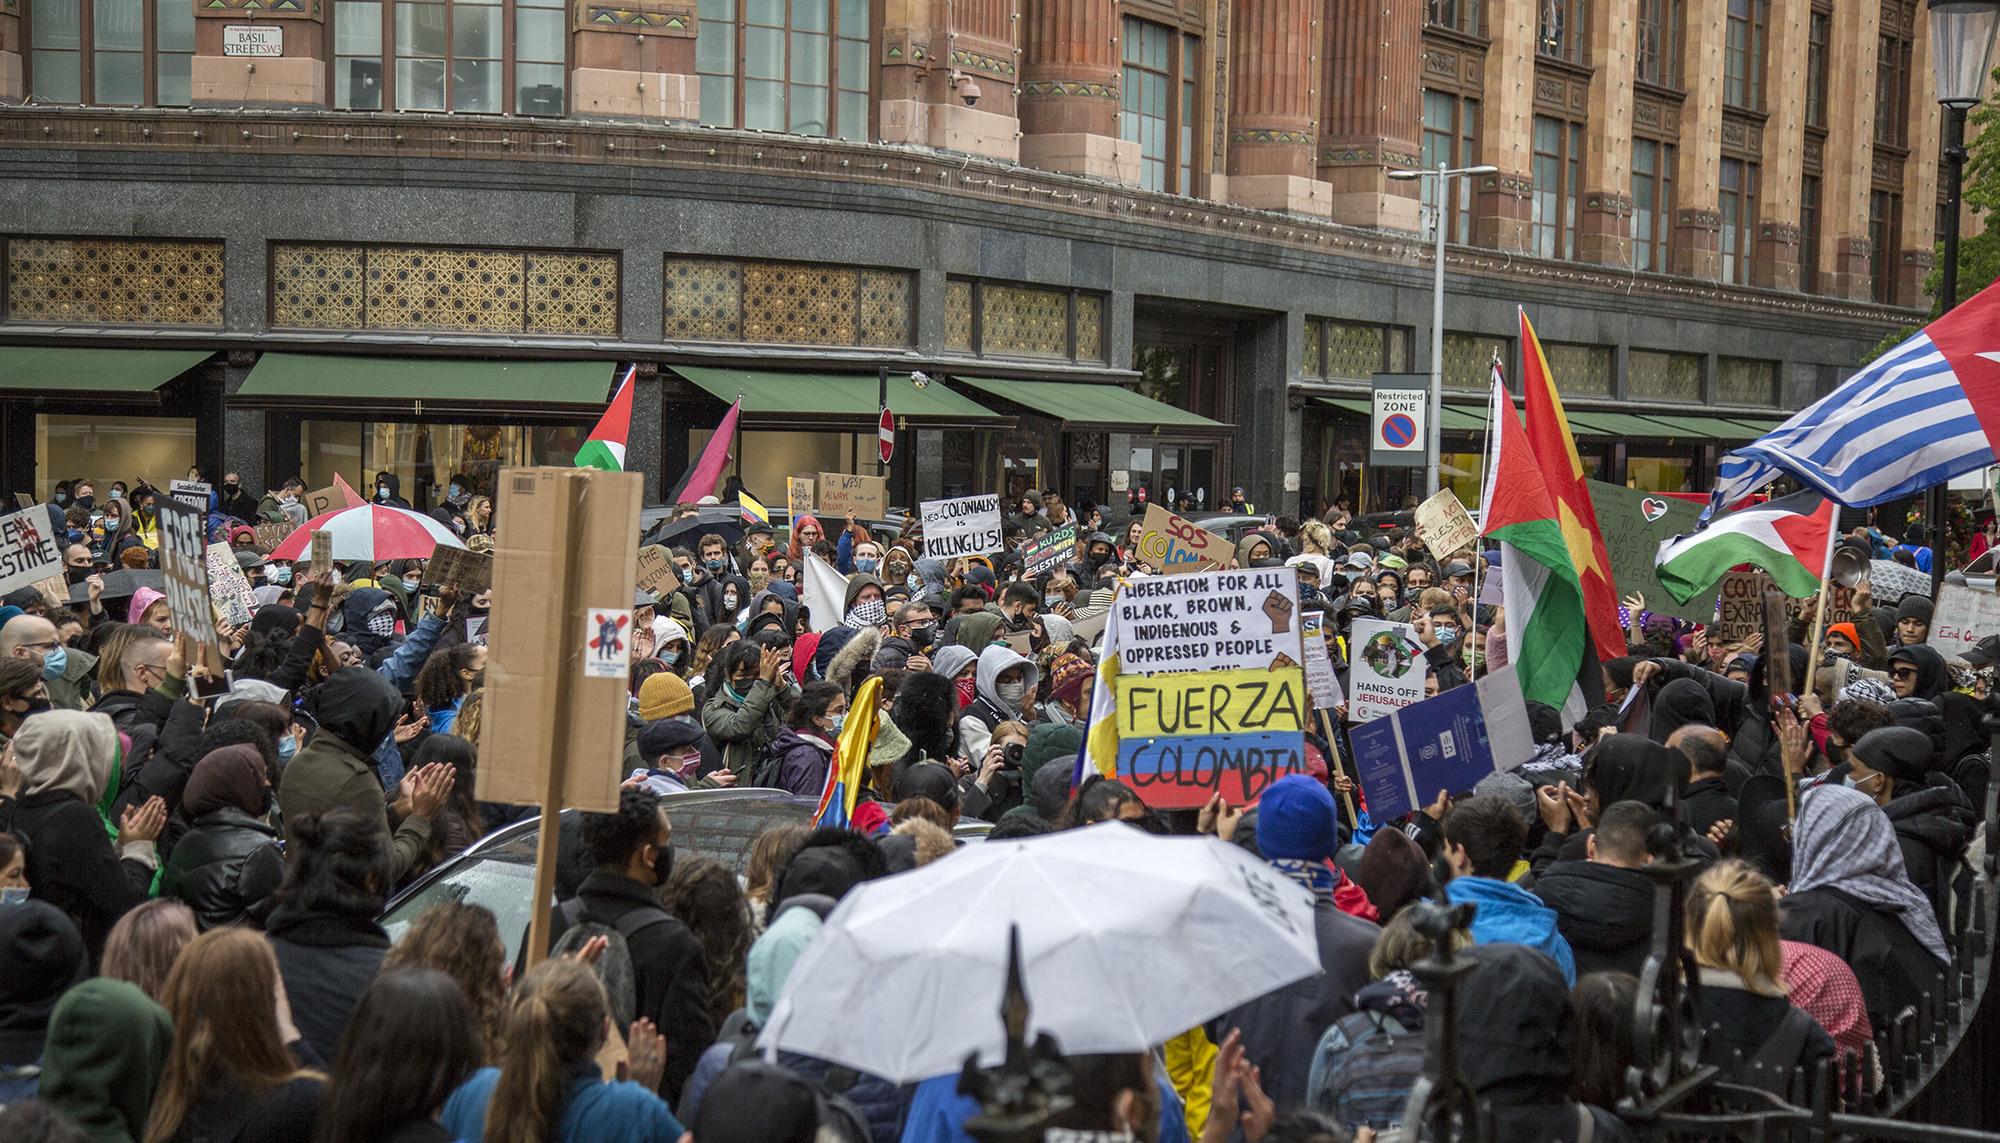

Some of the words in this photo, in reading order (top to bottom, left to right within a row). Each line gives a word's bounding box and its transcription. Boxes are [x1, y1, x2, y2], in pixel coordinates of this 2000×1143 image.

[239, 33, 267, 43] BASIL
[1377, 392, 1423, 400] Restricted
[1384, 402, 1416, 411] ZONE
[842, 477, 864, 489] WEST
[1442, 498, 1459, 520] NOT
[1039, 526, 1075, 549] KURDS
[1425, 513, 1469, 546] PALESTIN
[1438, 525, 1477, 555] EXPEN
[1054, 536, 1075, 552] WITH
[639, 548, 660, 569] THE
[1125, 577, 1209, 599] LIBERATION
[1218, 575, 1245, 591] FOR
[1253, 573, 1284, 590] ALL
[1122, 603, 1179, 621] BLACK,
[1187, 595, 1252, 615] BROWN,
[1134, 621, 1218, 641] INDIGENOUS
[1230, 620, 1242, 635] &
[1939, 626, 1960, 639] End
[1126, 642, 1210, 664] OPPRESSED
[1215, 639, 1273, 657] PEOPLE
[1357, 681, 1394, 695] HANDS
[1397, 687, 1418, 698] OFF
[1129, 681, 1304, 734] FUERZA
[1130, 742, 1300, 801] COLOMBIA
